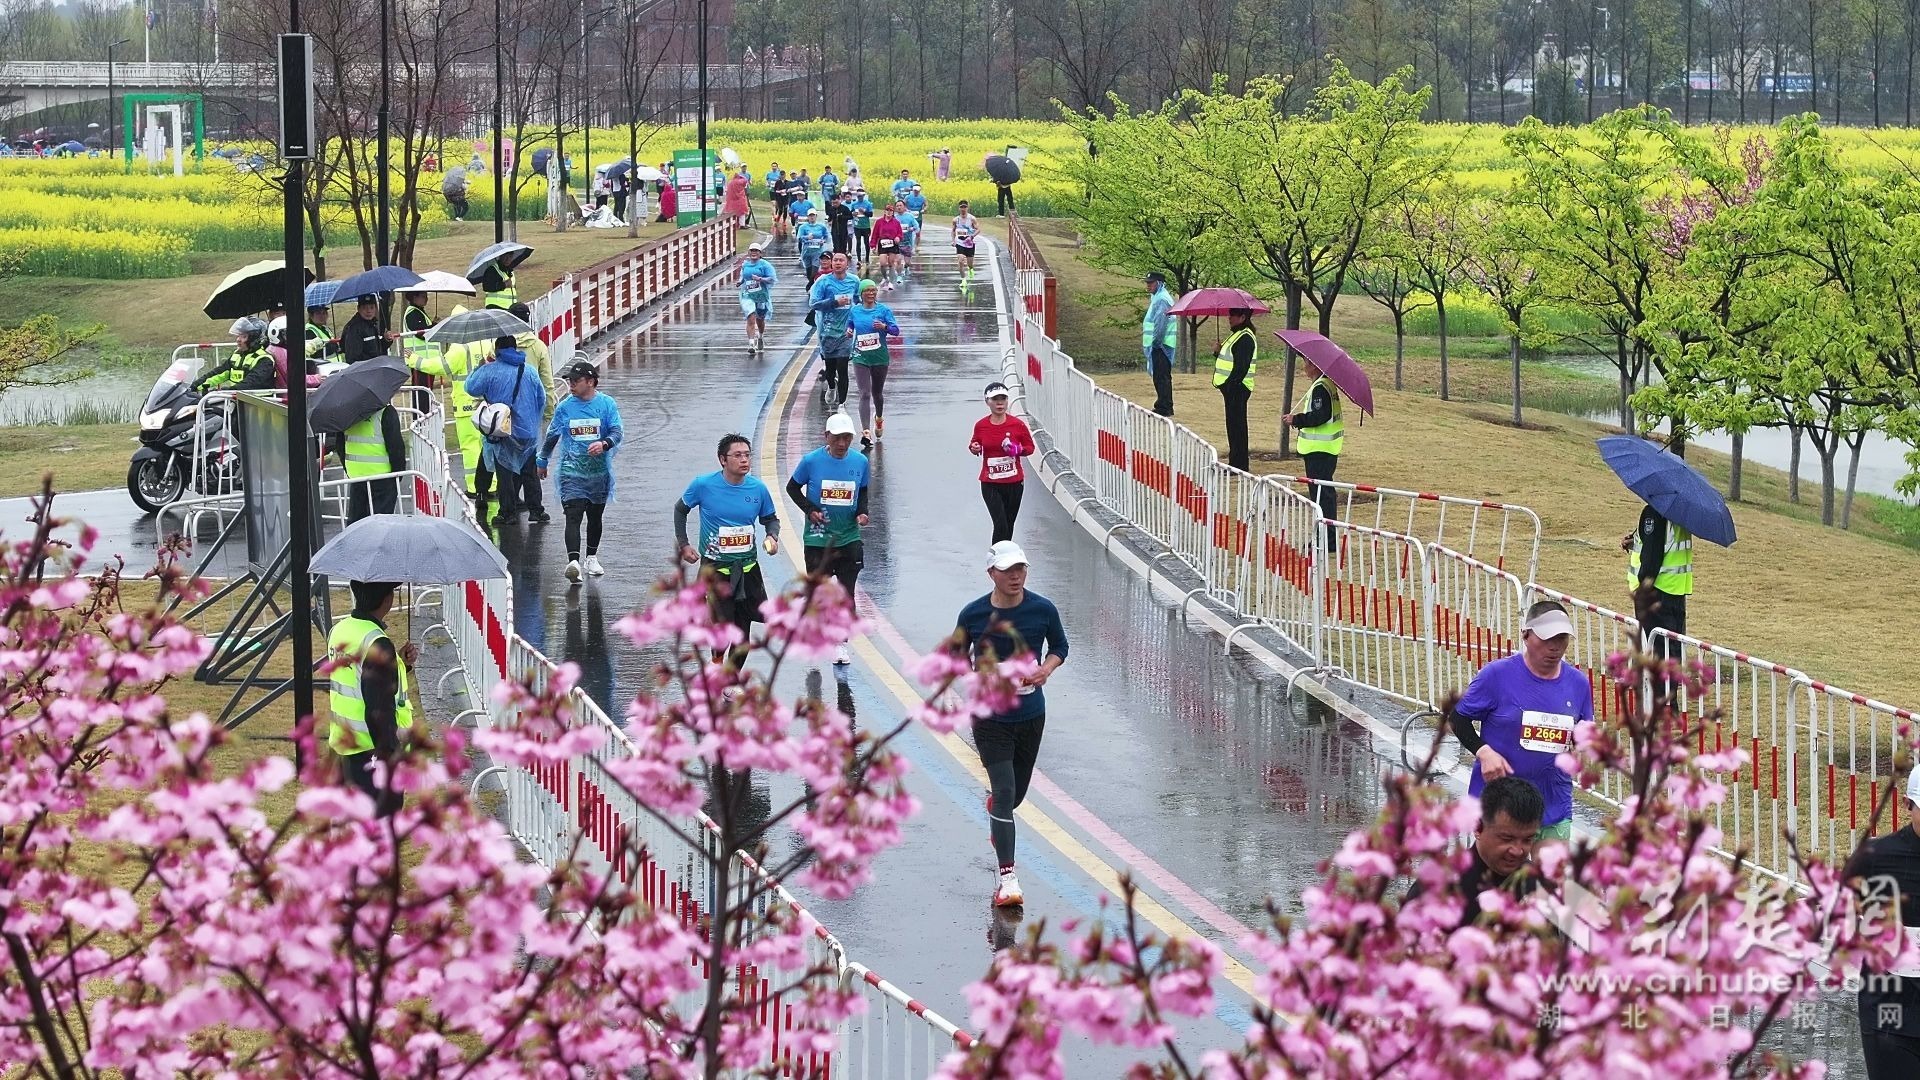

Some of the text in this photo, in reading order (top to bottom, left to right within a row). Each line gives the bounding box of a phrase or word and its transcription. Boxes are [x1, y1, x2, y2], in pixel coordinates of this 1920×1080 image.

[830, 490, 849, 498] 2857
[720, 536, 748, 546] B 3128
[1523, 727, 1563, 741] B 2664
